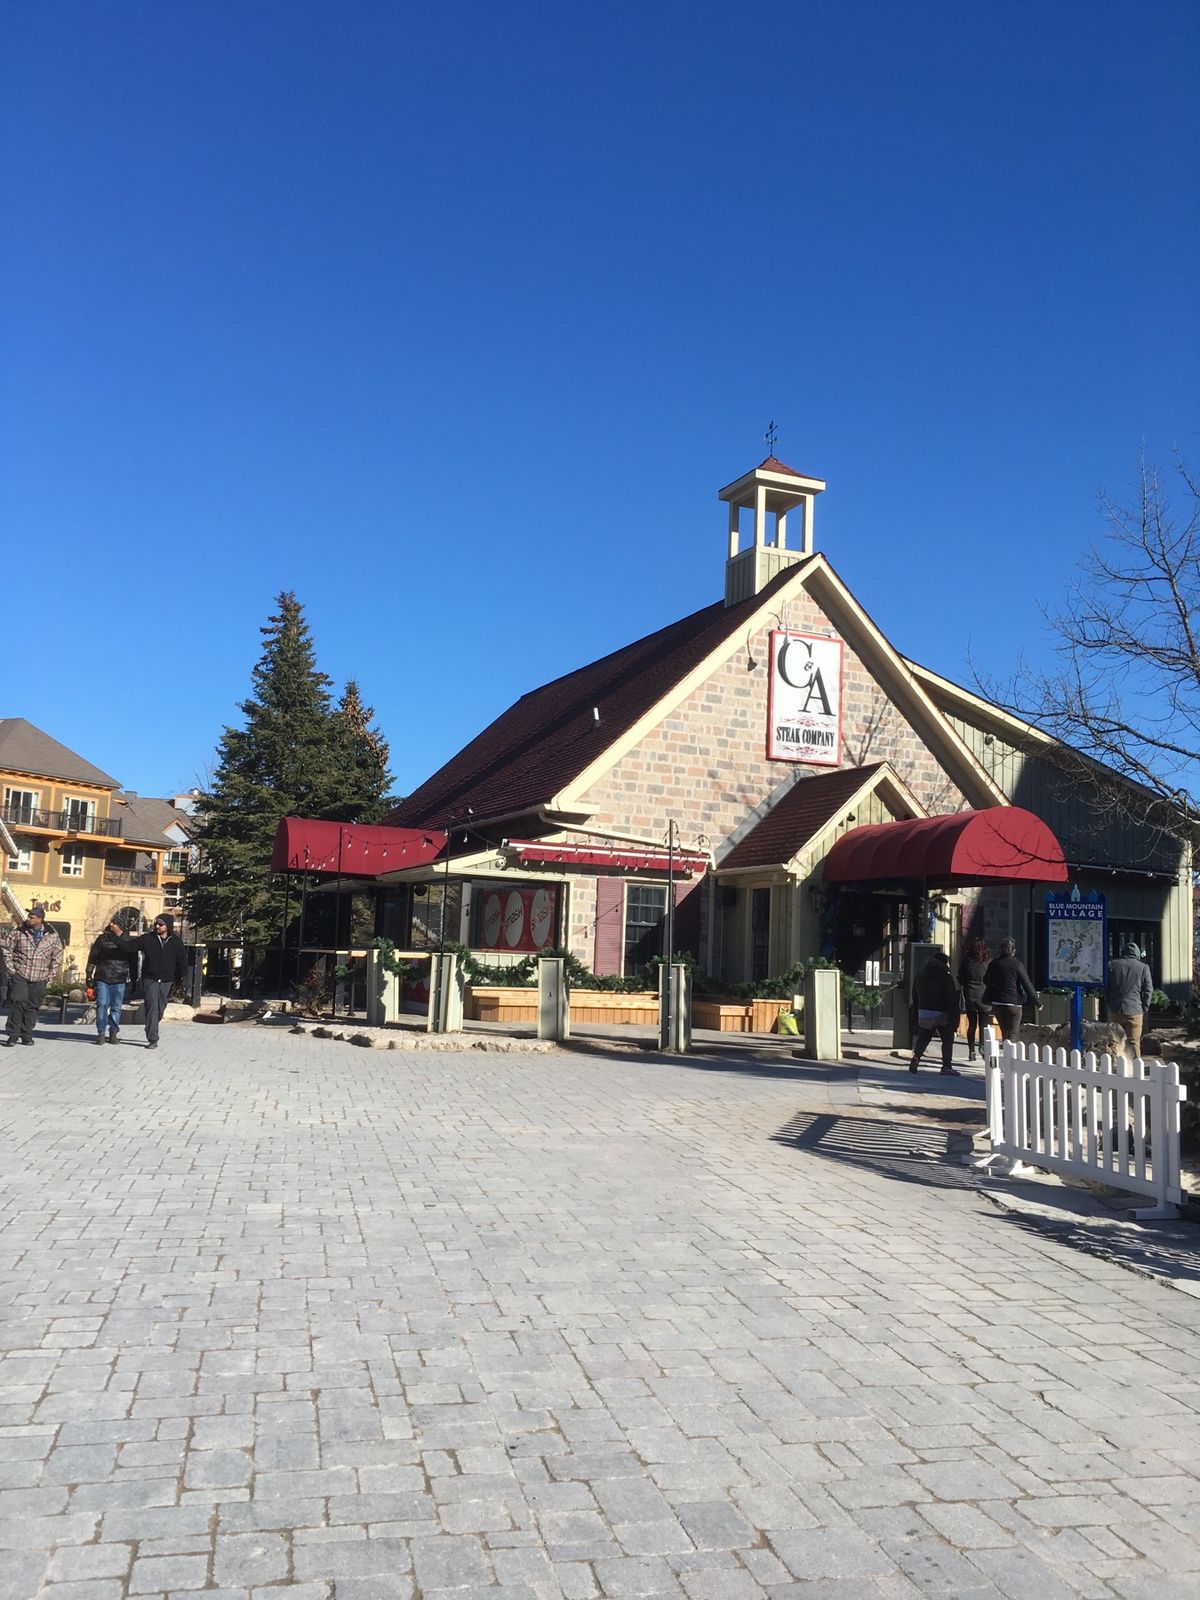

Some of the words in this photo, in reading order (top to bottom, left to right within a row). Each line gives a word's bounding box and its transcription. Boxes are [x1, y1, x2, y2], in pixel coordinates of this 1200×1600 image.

[776, 726, 801, 744] STEAK
[802, 728, 835, 747] COMPANY
[1049, 909, 1103, 917] VILLAGE
